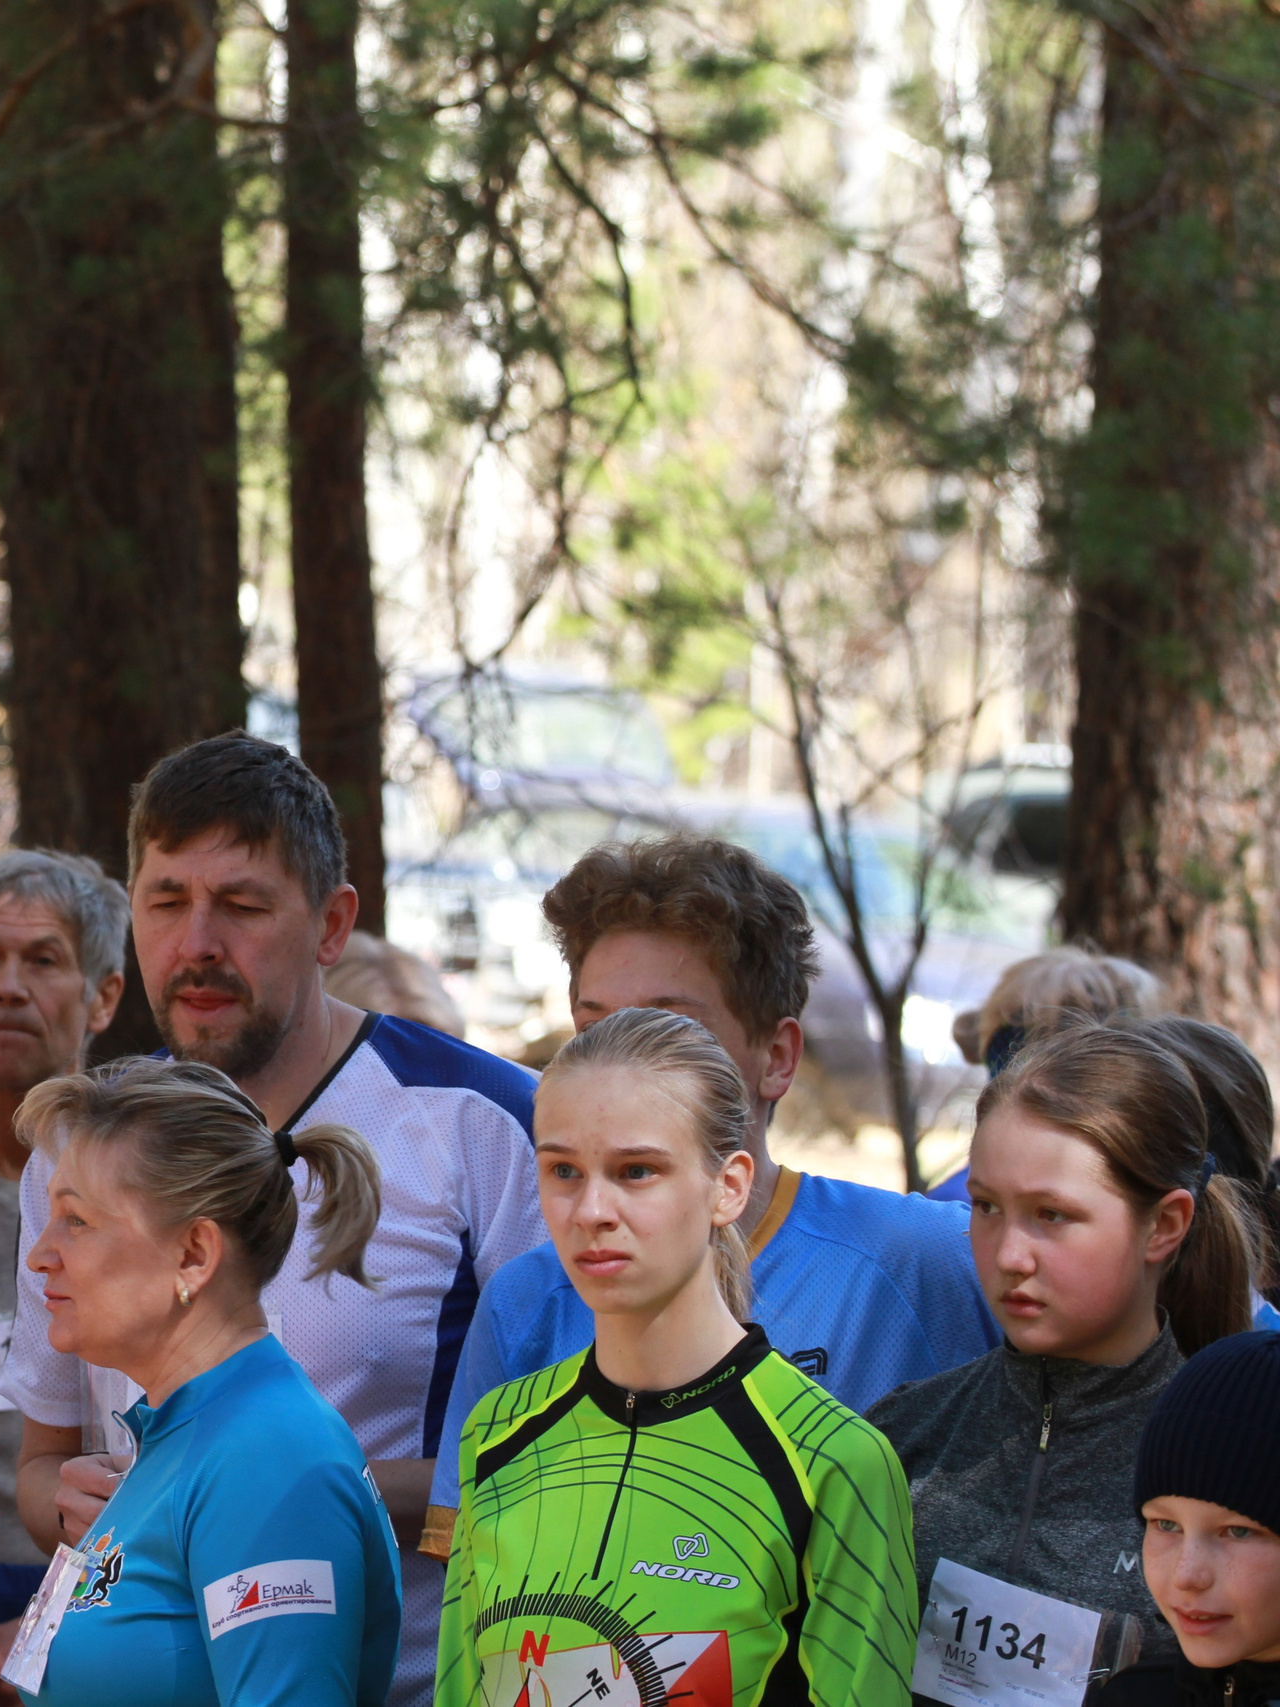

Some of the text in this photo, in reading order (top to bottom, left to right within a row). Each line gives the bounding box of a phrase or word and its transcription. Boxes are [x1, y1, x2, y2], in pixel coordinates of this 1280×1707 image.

[681, 1365, 736, 1400] NORD
[262, 1579, 314, 1600] Ермак
[630, 1560, 740, 1590] NORD
[225, 1602, 269, 1621] спортивного
[271, 1598, 332, 1607] ориентирования
[520, 1629, 550, 1667] N
[951, 1606, 1046, 1669] 1134
[586, 1667, 611, 1701] NE
